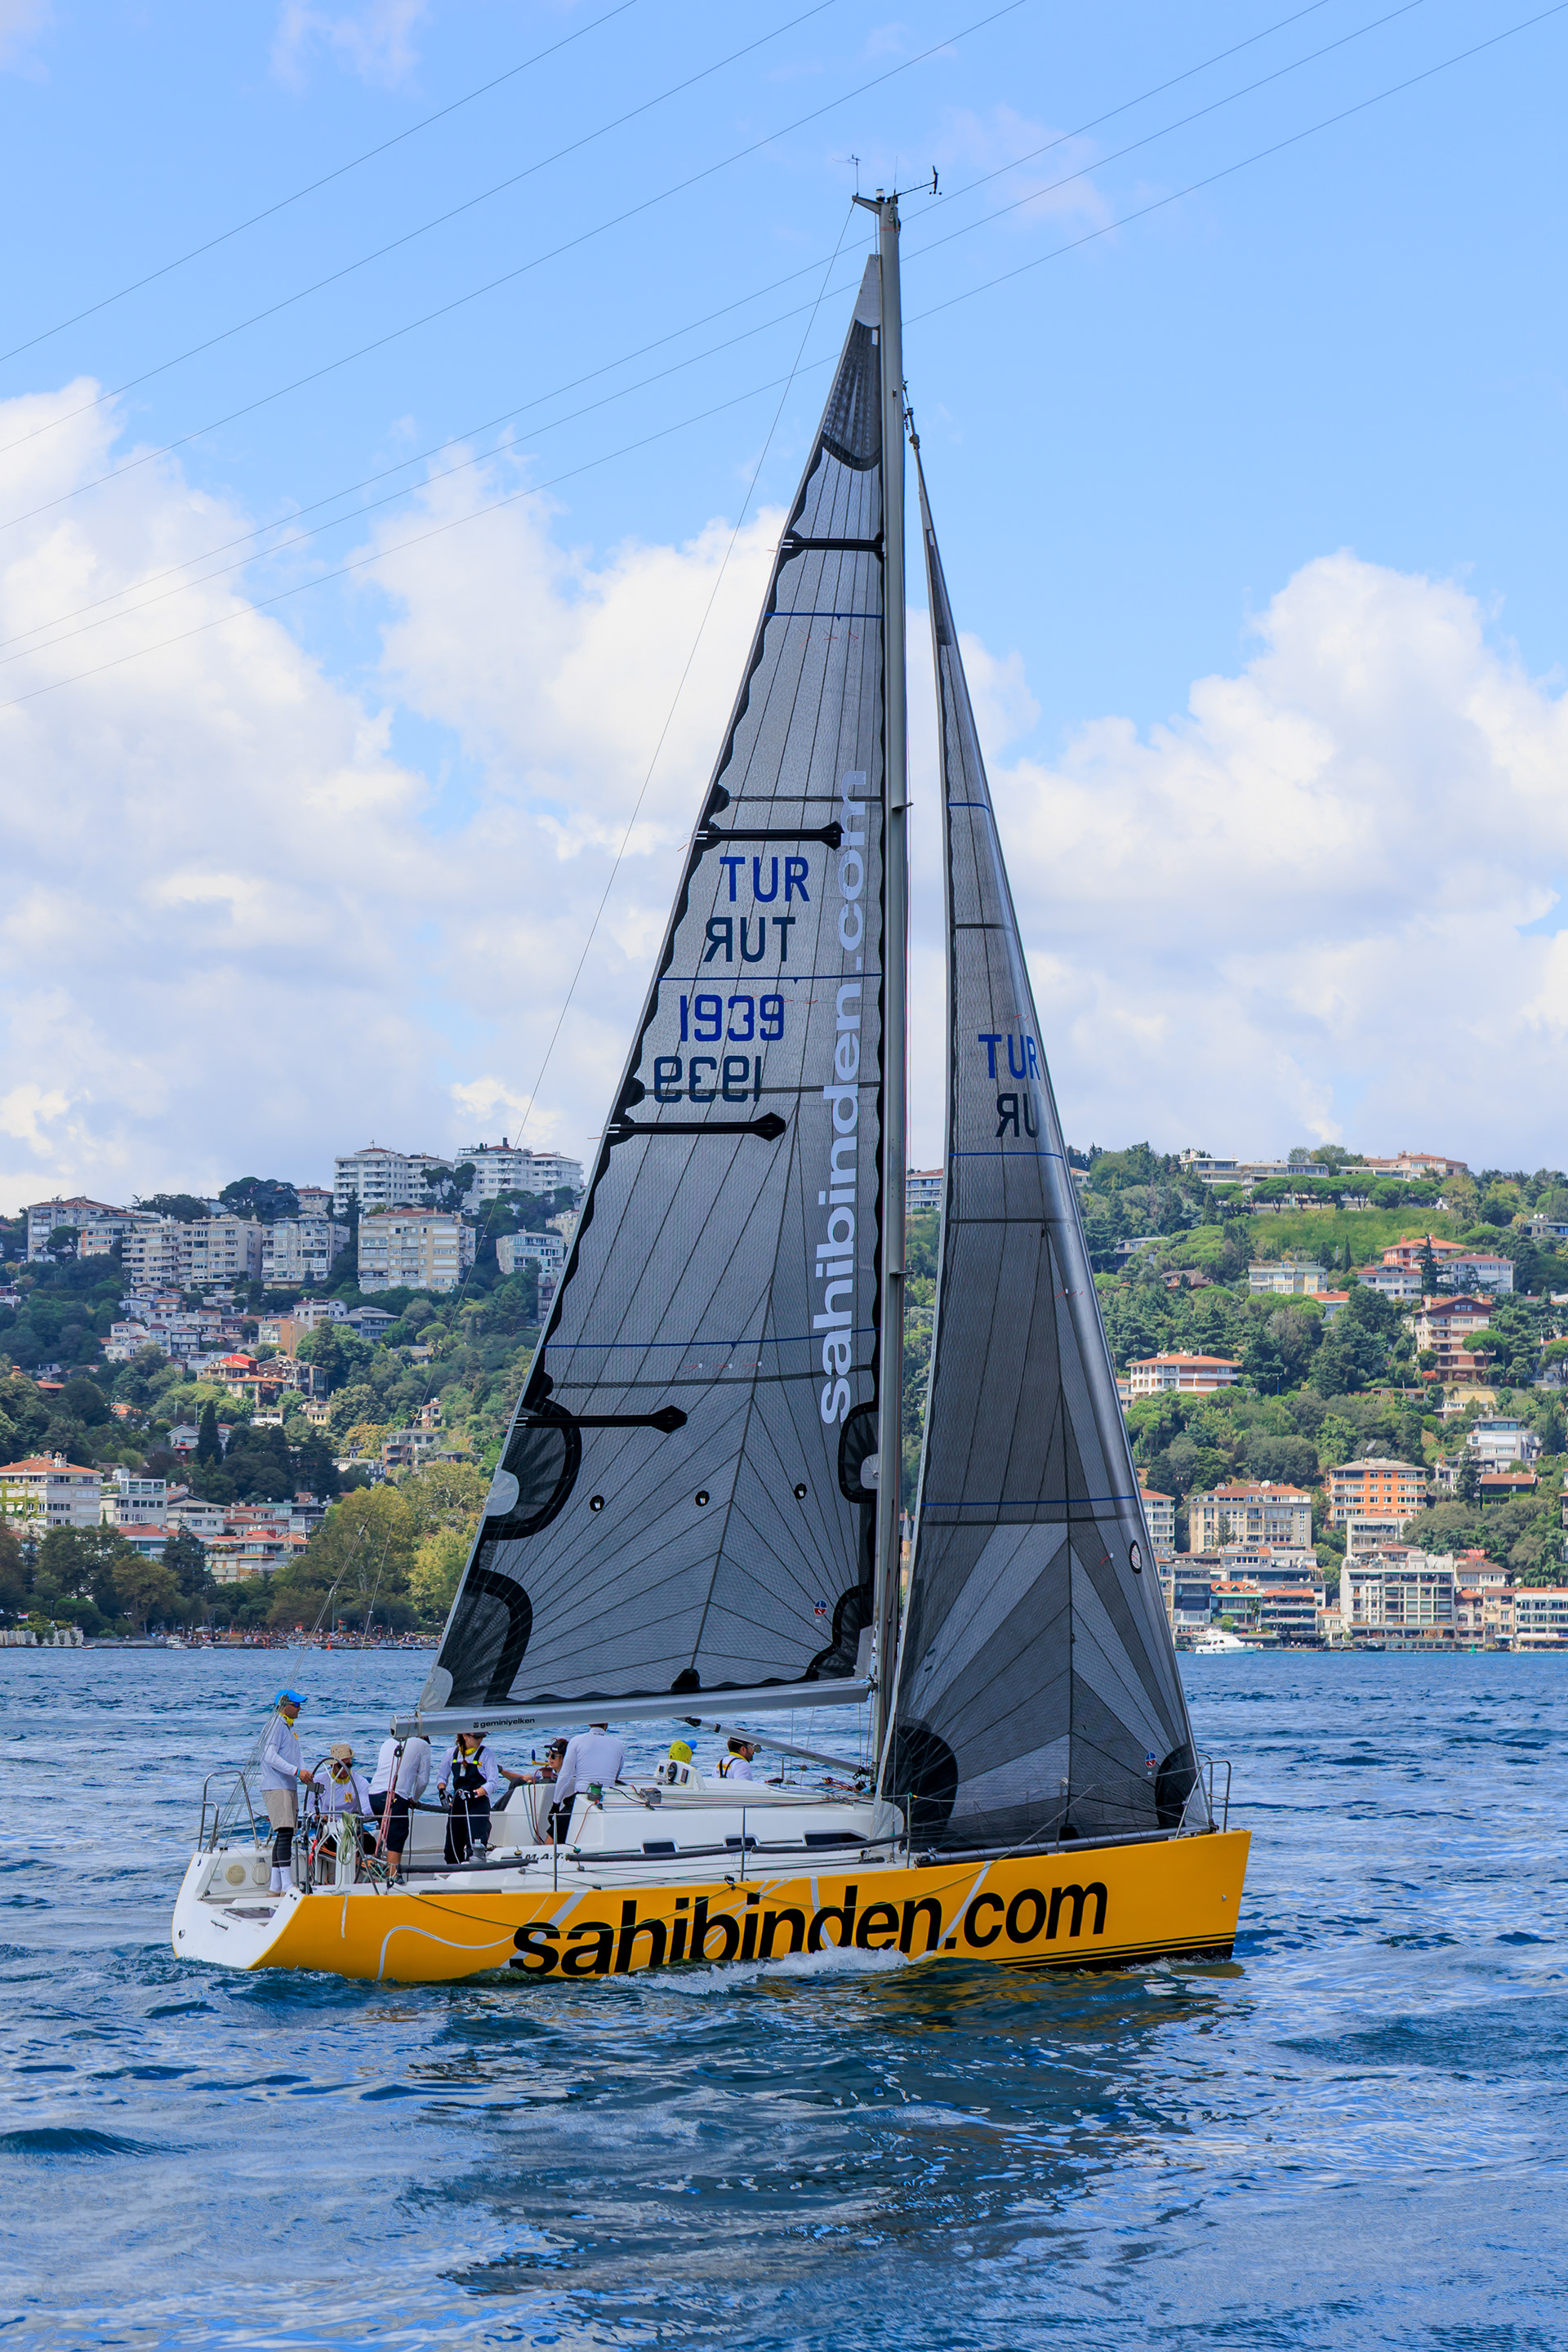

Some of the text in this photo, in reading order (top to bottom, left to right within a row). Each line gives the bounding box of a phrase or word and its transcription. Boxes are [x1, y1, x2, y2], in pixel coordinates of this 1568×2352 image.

[719, 857, 810, 902] TUR
[679, 994, 784, 1042] 1939
[978, 1034, 1040, 1080] TUR
[813, 770, 866, 1424] sahibinden.com
[480, 1717, 535, 1728] geminiyelken
[509, 1881, 1107, 1976] sahibinden.com
